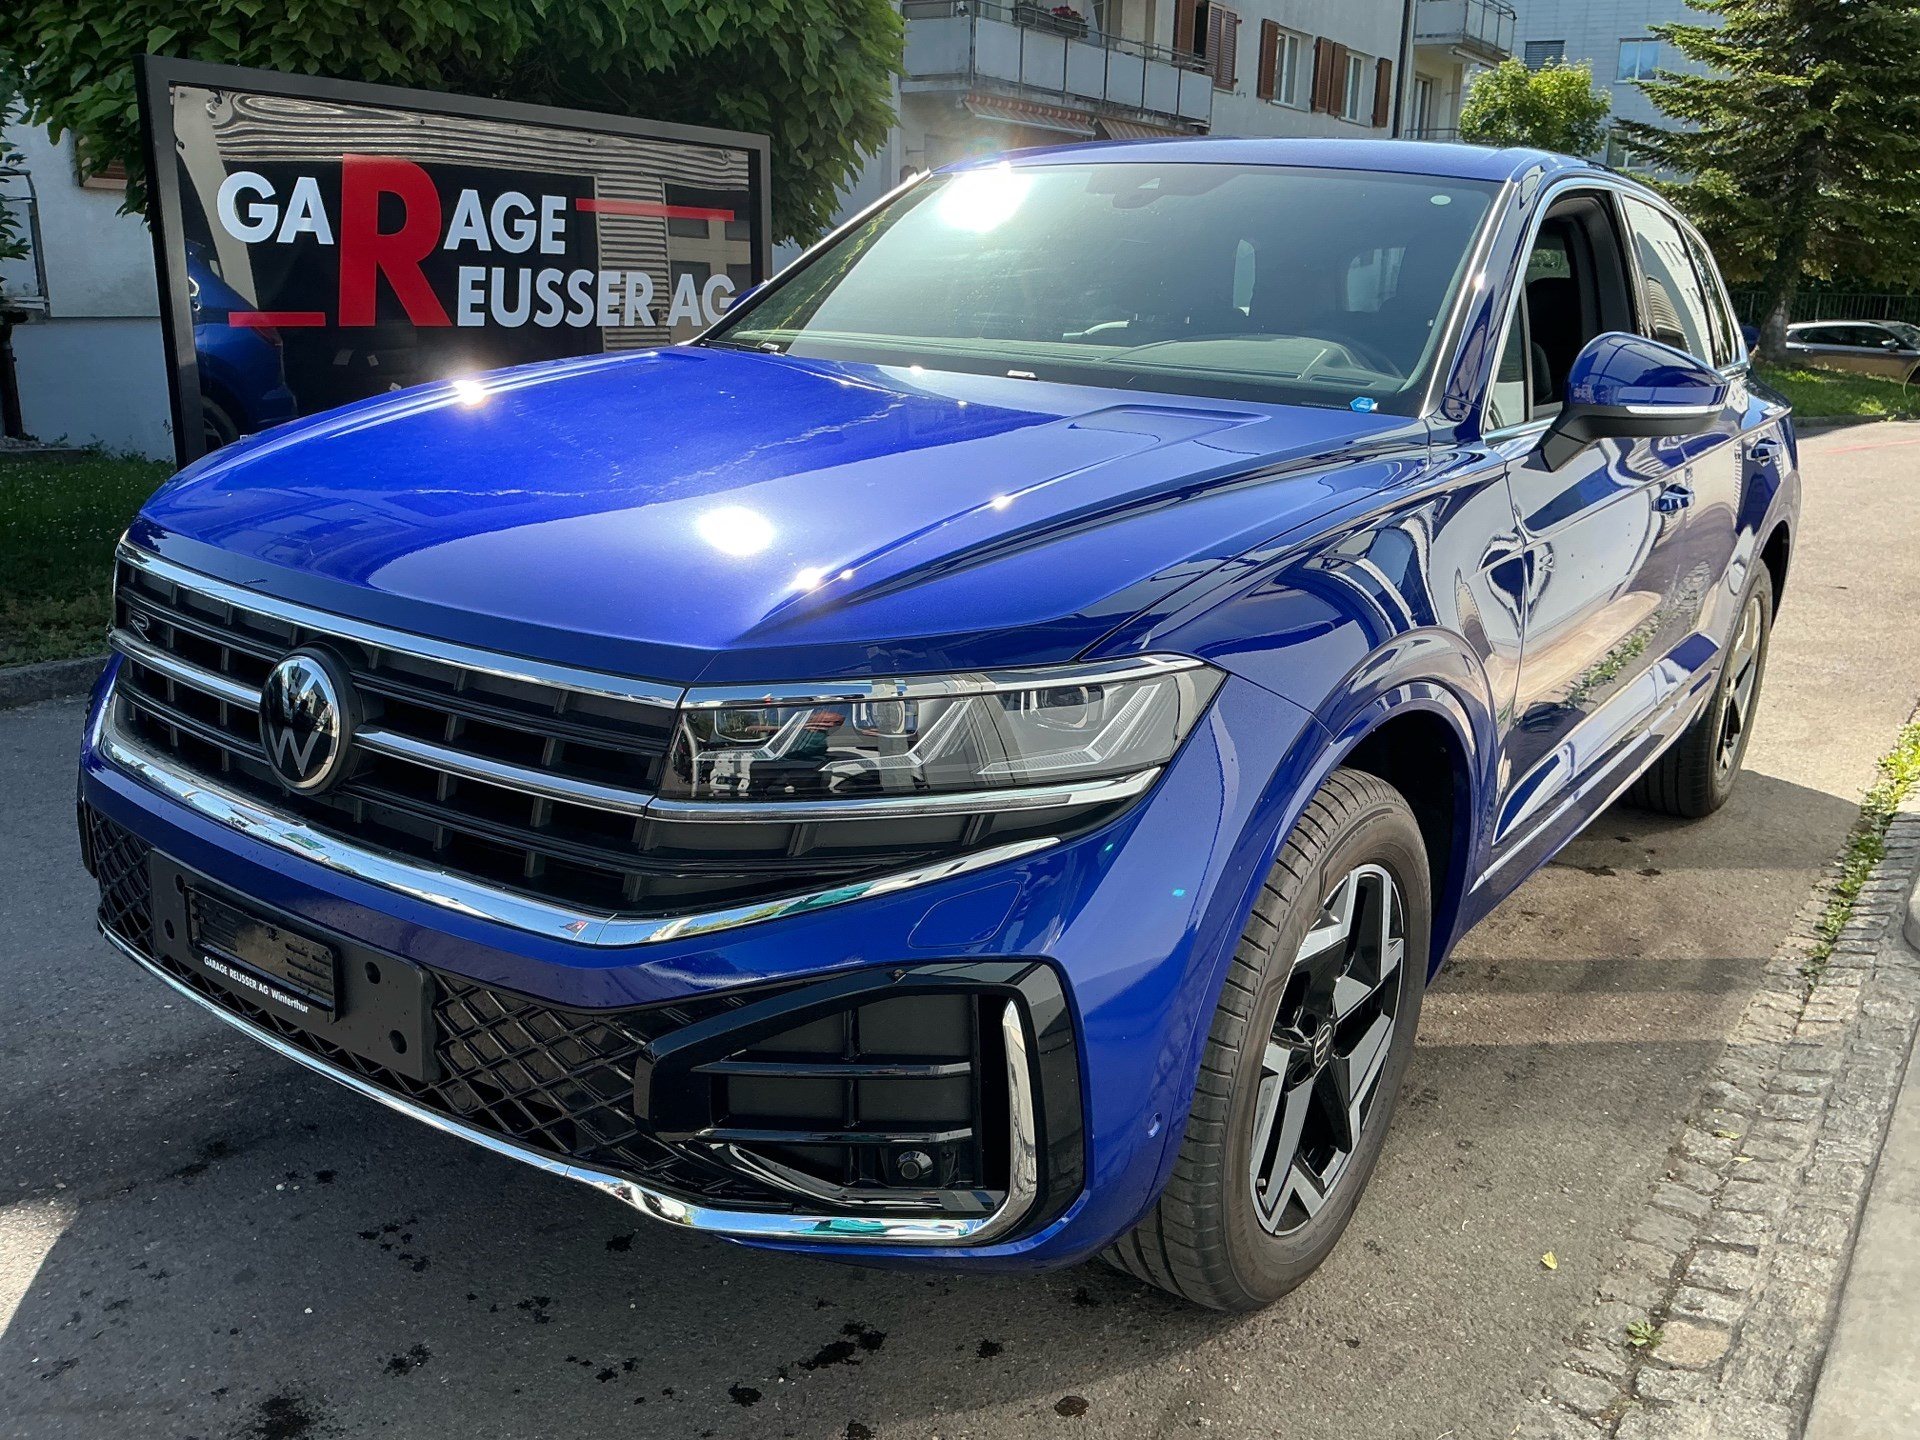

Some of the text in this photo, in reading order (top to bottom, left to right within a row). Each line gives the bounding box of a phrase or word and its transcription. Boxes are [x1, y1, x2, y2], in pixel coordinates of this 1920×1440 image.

[666, 273, 737, 327] AG
[204, 956, 308, 1013] GARAGE REUSSER AG Winterthur
